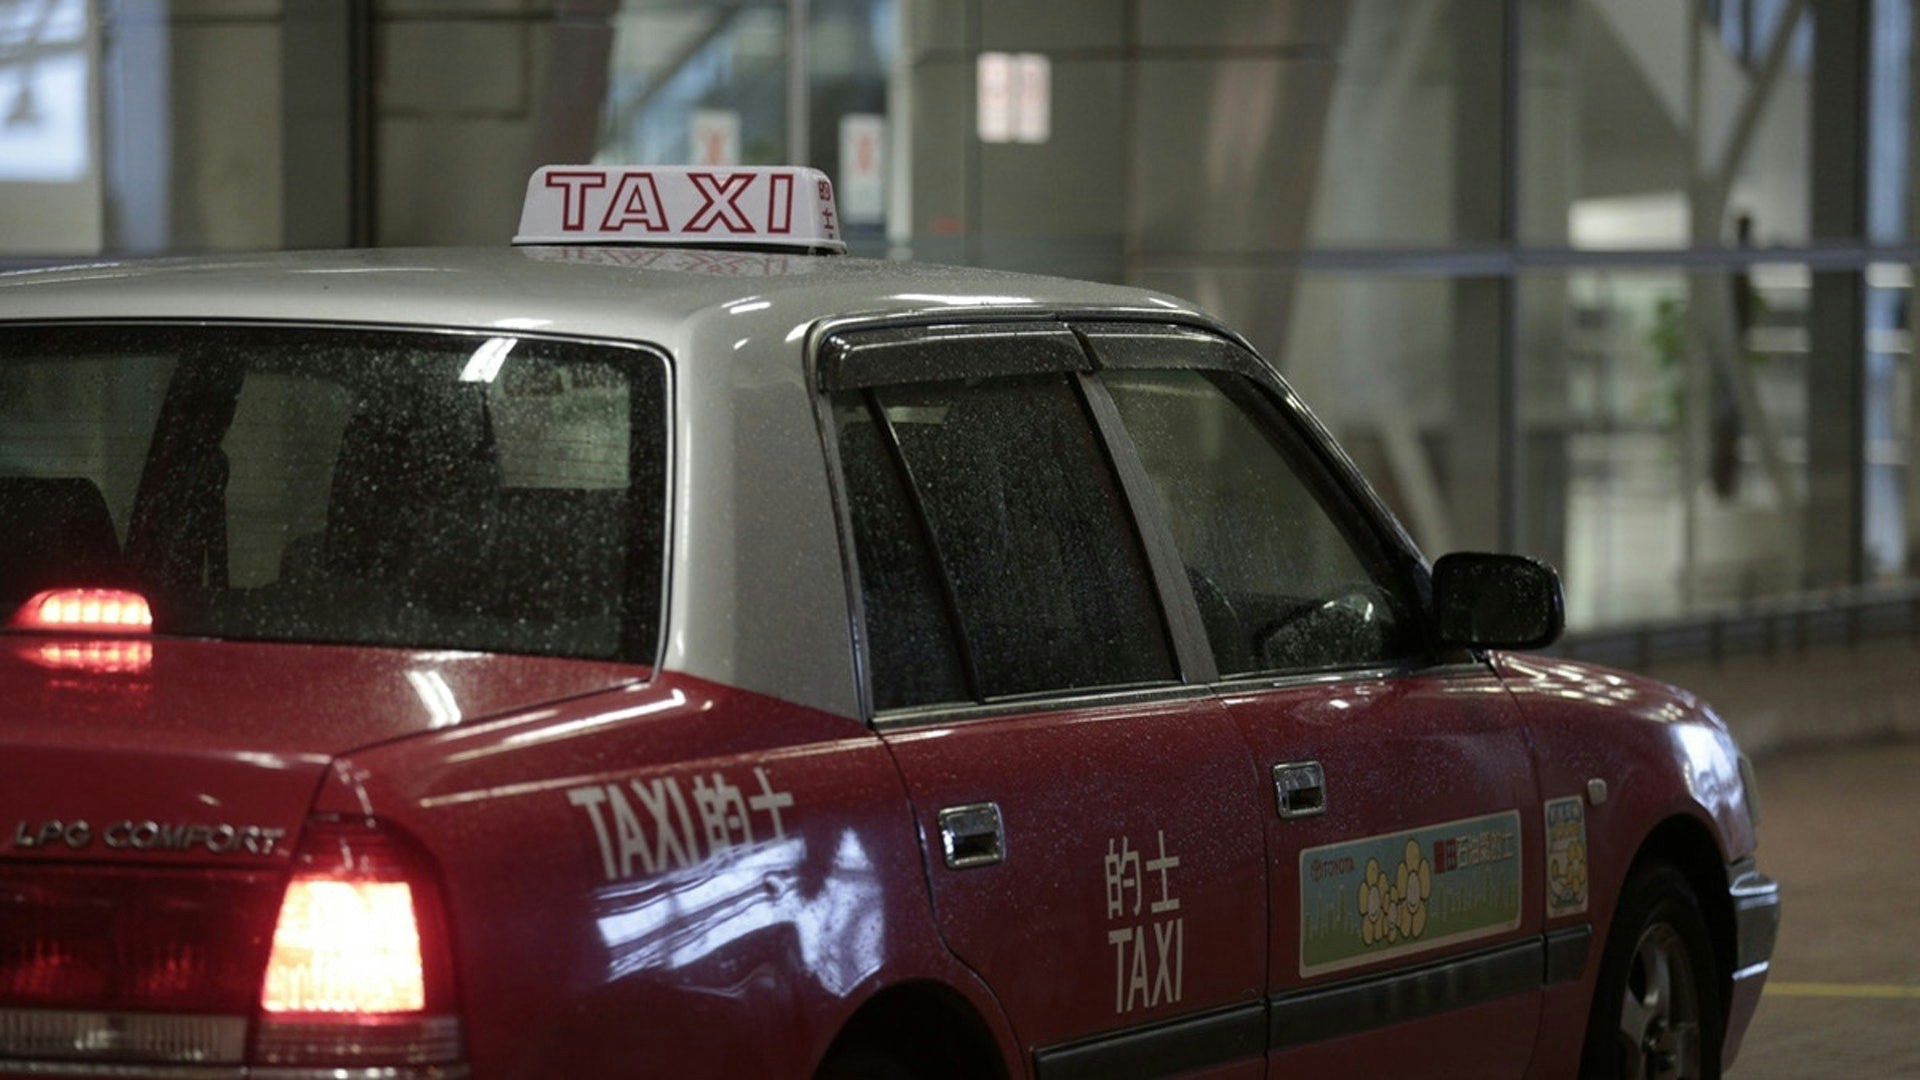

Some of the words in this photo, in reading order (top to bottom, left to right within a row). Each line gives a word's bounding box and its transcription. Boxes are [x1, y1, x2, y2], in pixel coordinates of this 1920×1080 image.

[545, 171, 795, 234] TAXI
[817, 180, 835, 230] 的士
[14, 819, 92, 849] LPG
[103, 820, 286, 855] COMFORT
[567, 777, 701, 880] TAXI
[692, 767, 794, 858] 的士
[1104, 829, 1180, 920] 的士
[1107, 917, 1184, 1014] TAXI
